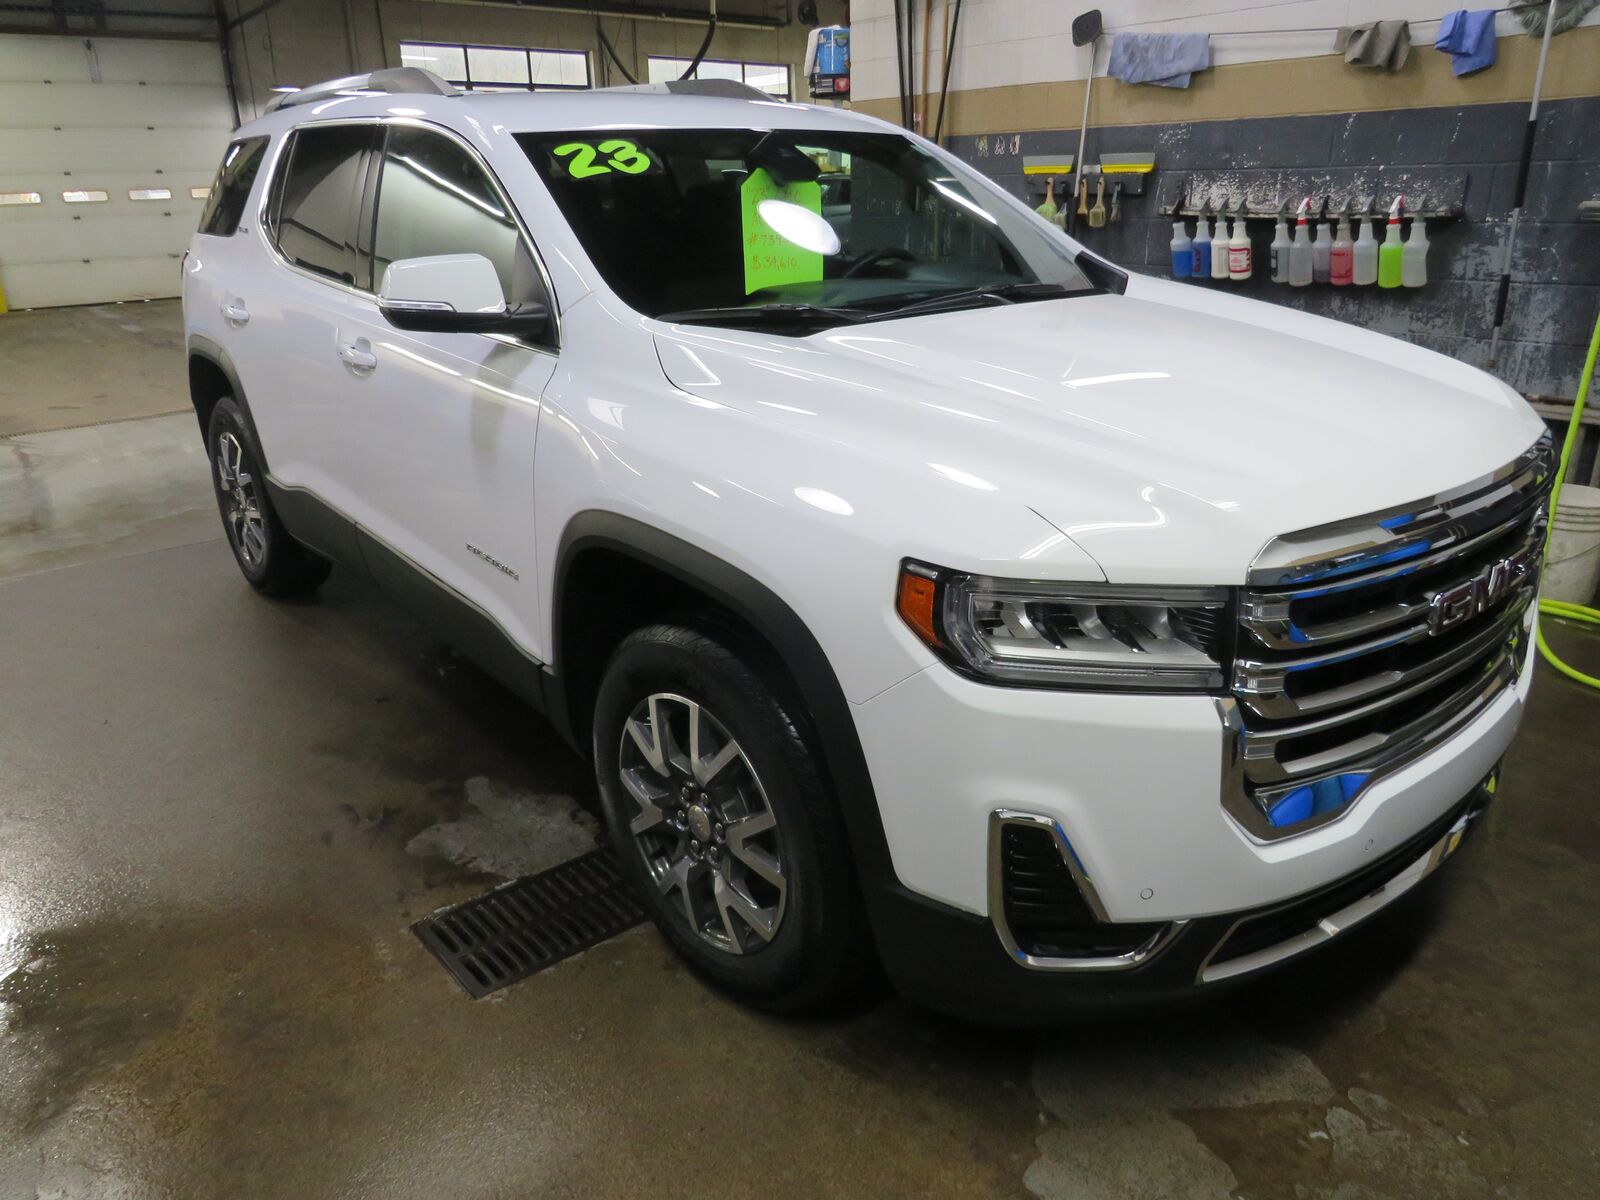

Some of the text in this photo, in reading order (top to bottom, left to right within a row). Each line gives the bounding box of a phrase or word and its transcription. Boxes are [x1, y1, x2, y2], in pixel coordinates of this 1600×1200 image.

[553, 140, 652, 179] 23
[747, 231, 783, 247] #739
[1427, 549, 1530, 637] GMC
